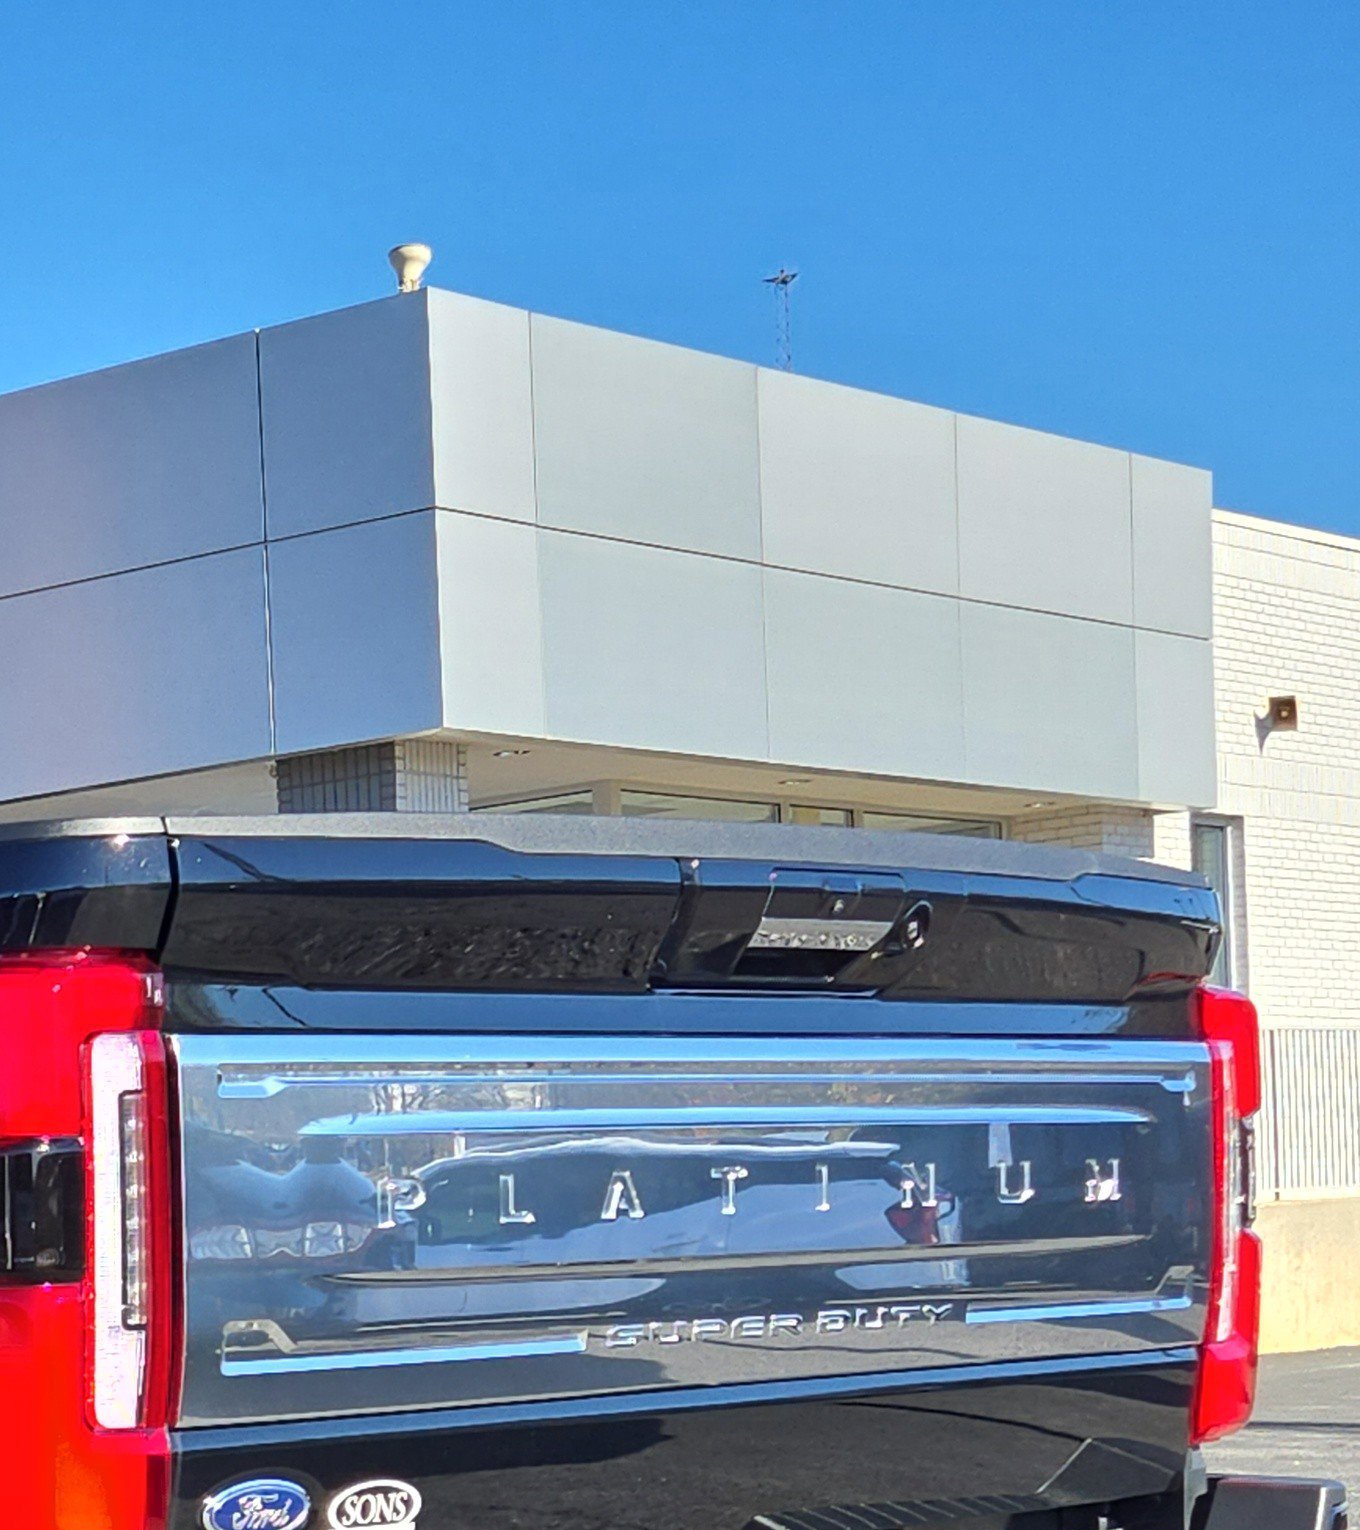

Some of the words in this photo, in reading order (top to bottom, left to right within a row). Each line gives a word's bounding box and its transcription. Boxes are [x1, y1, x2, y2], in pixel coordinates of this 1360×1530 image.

[377, 1158, 1122, 1230] PLATINUM
[605, 1312, 804, 1348] SUPER
[815, 1303, 954, 1334] DUTY
[232, 1494, 293, 1530] Ford
[342, 1492, 408, 1526] SONS
